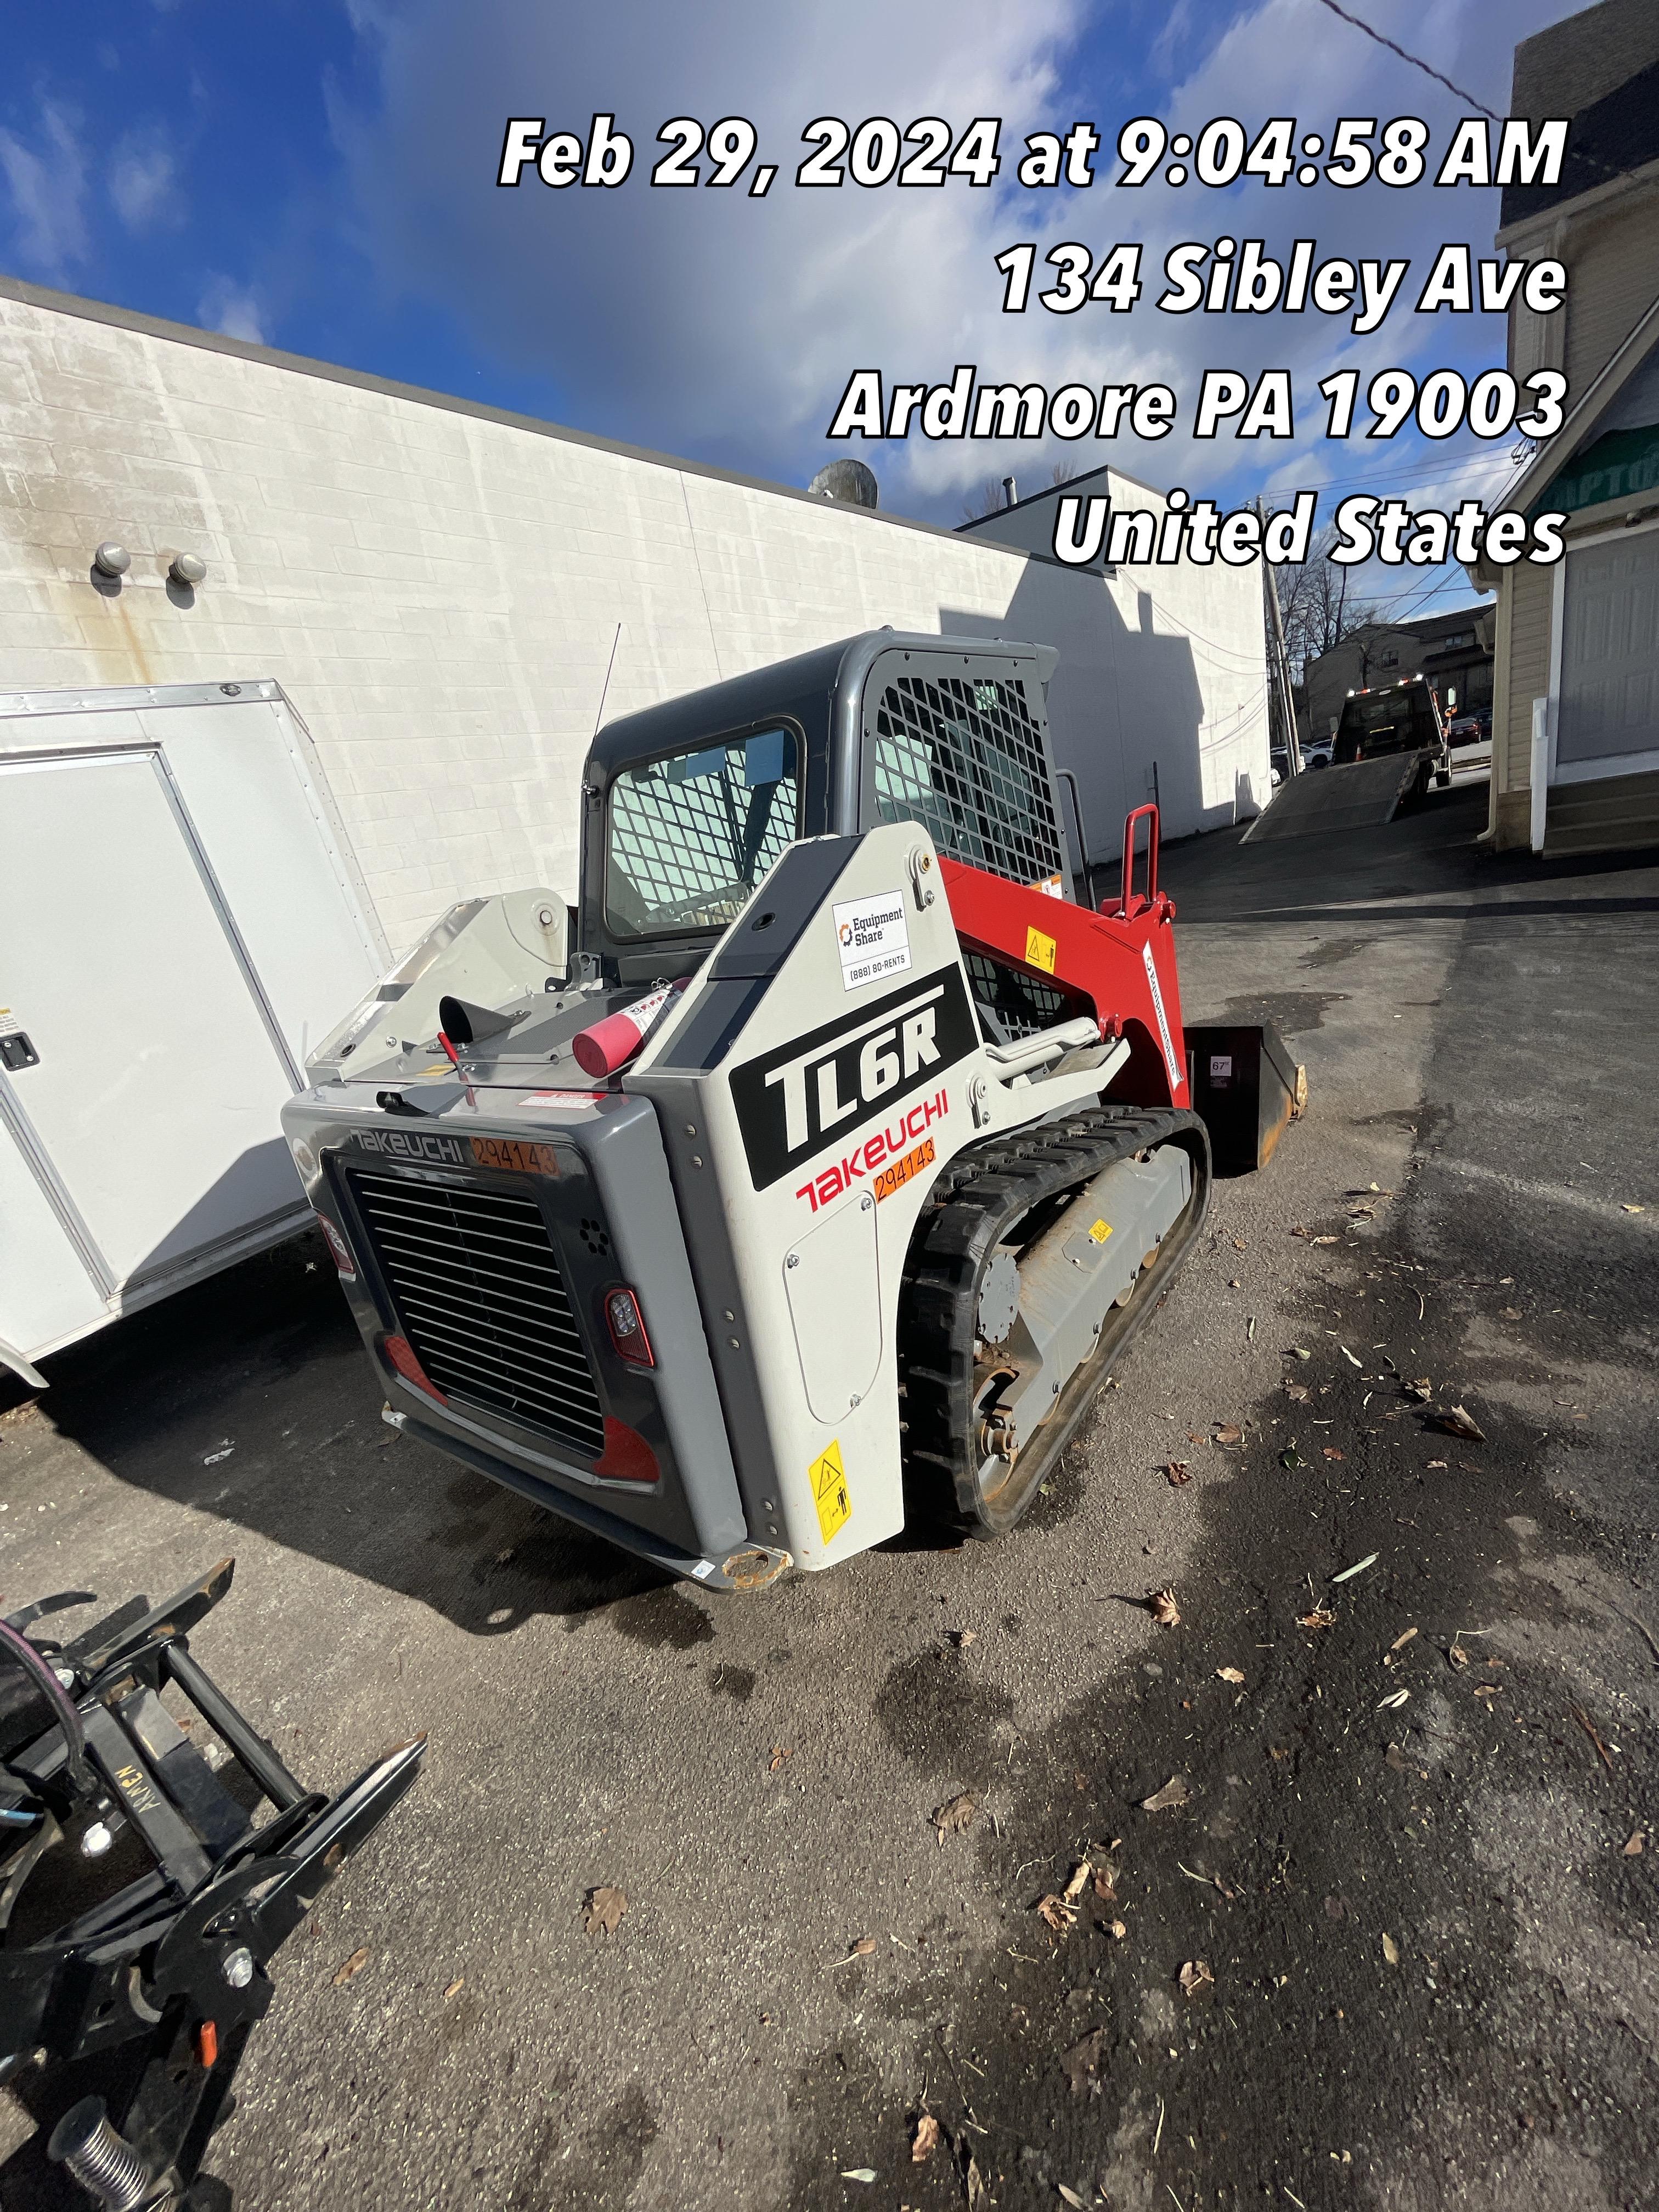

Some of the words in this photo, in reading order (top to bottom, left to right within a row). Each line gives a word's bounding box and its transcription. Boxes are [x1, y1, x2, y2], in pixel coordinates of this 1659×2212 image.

[853, 907, 903, 932] Equipment
[850, 965, 871, 981] (888)
[872, 955, 905, 973] 80-RENTS
[765, 984, 944, 1153] TL6R
[473, 1137, 558, 1175] 294143
[875, 1139, 935, 1201] 294143
